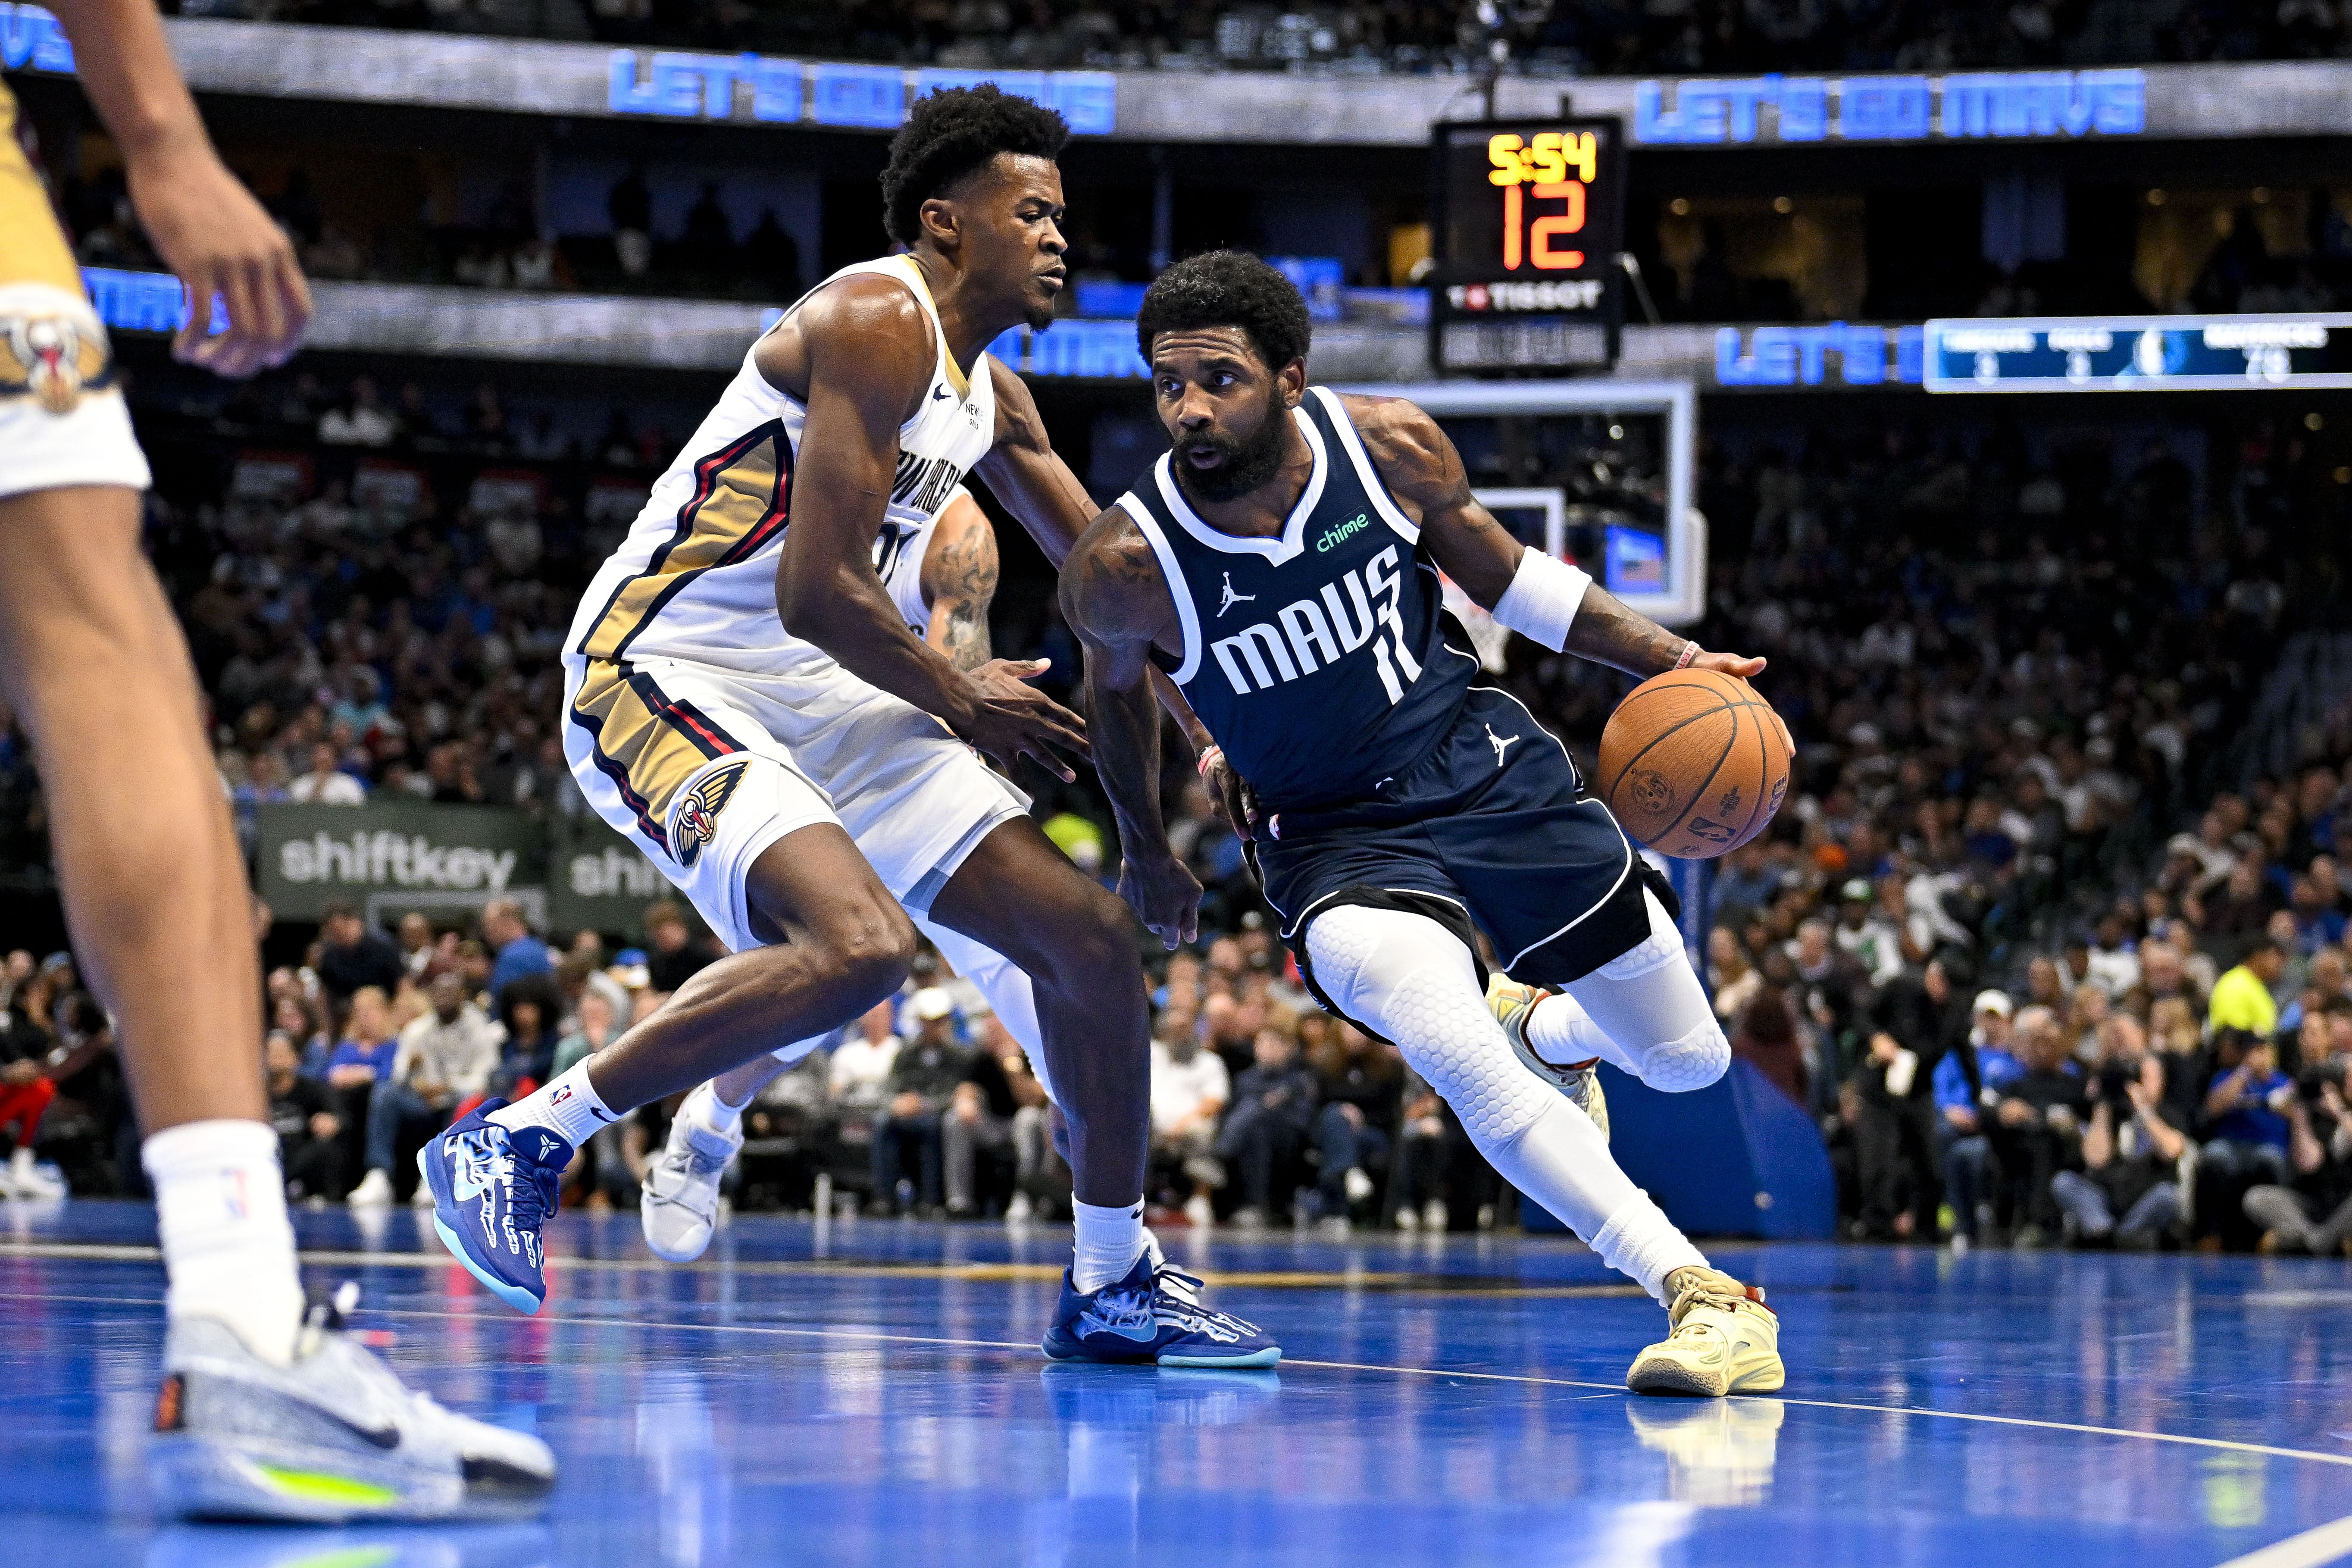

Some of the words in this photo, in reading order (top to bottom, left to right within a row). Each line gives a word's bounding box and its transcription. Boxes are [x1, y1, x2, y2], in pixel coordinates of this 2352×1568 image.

[608, 49, 802, 123] LET'S
[814, 62, 903, 129] GO
[1638, 72, 1827, 144] LET'S
[1839, 76, 1929, 141] GO
[1942, 68, 2146, 139] MAVS
[1489, 132, 1597, 186] 5:54
[1504, 180, 1585, 271] 12
[1715, 320, 1885, 385] LET'S
[1317, 514, 1369, 552] chime
[1210, 544, 1400, 695] MAVS
[1373, 606, 1422, 705] 11
[280, 830, 516, 890] shiftkey
